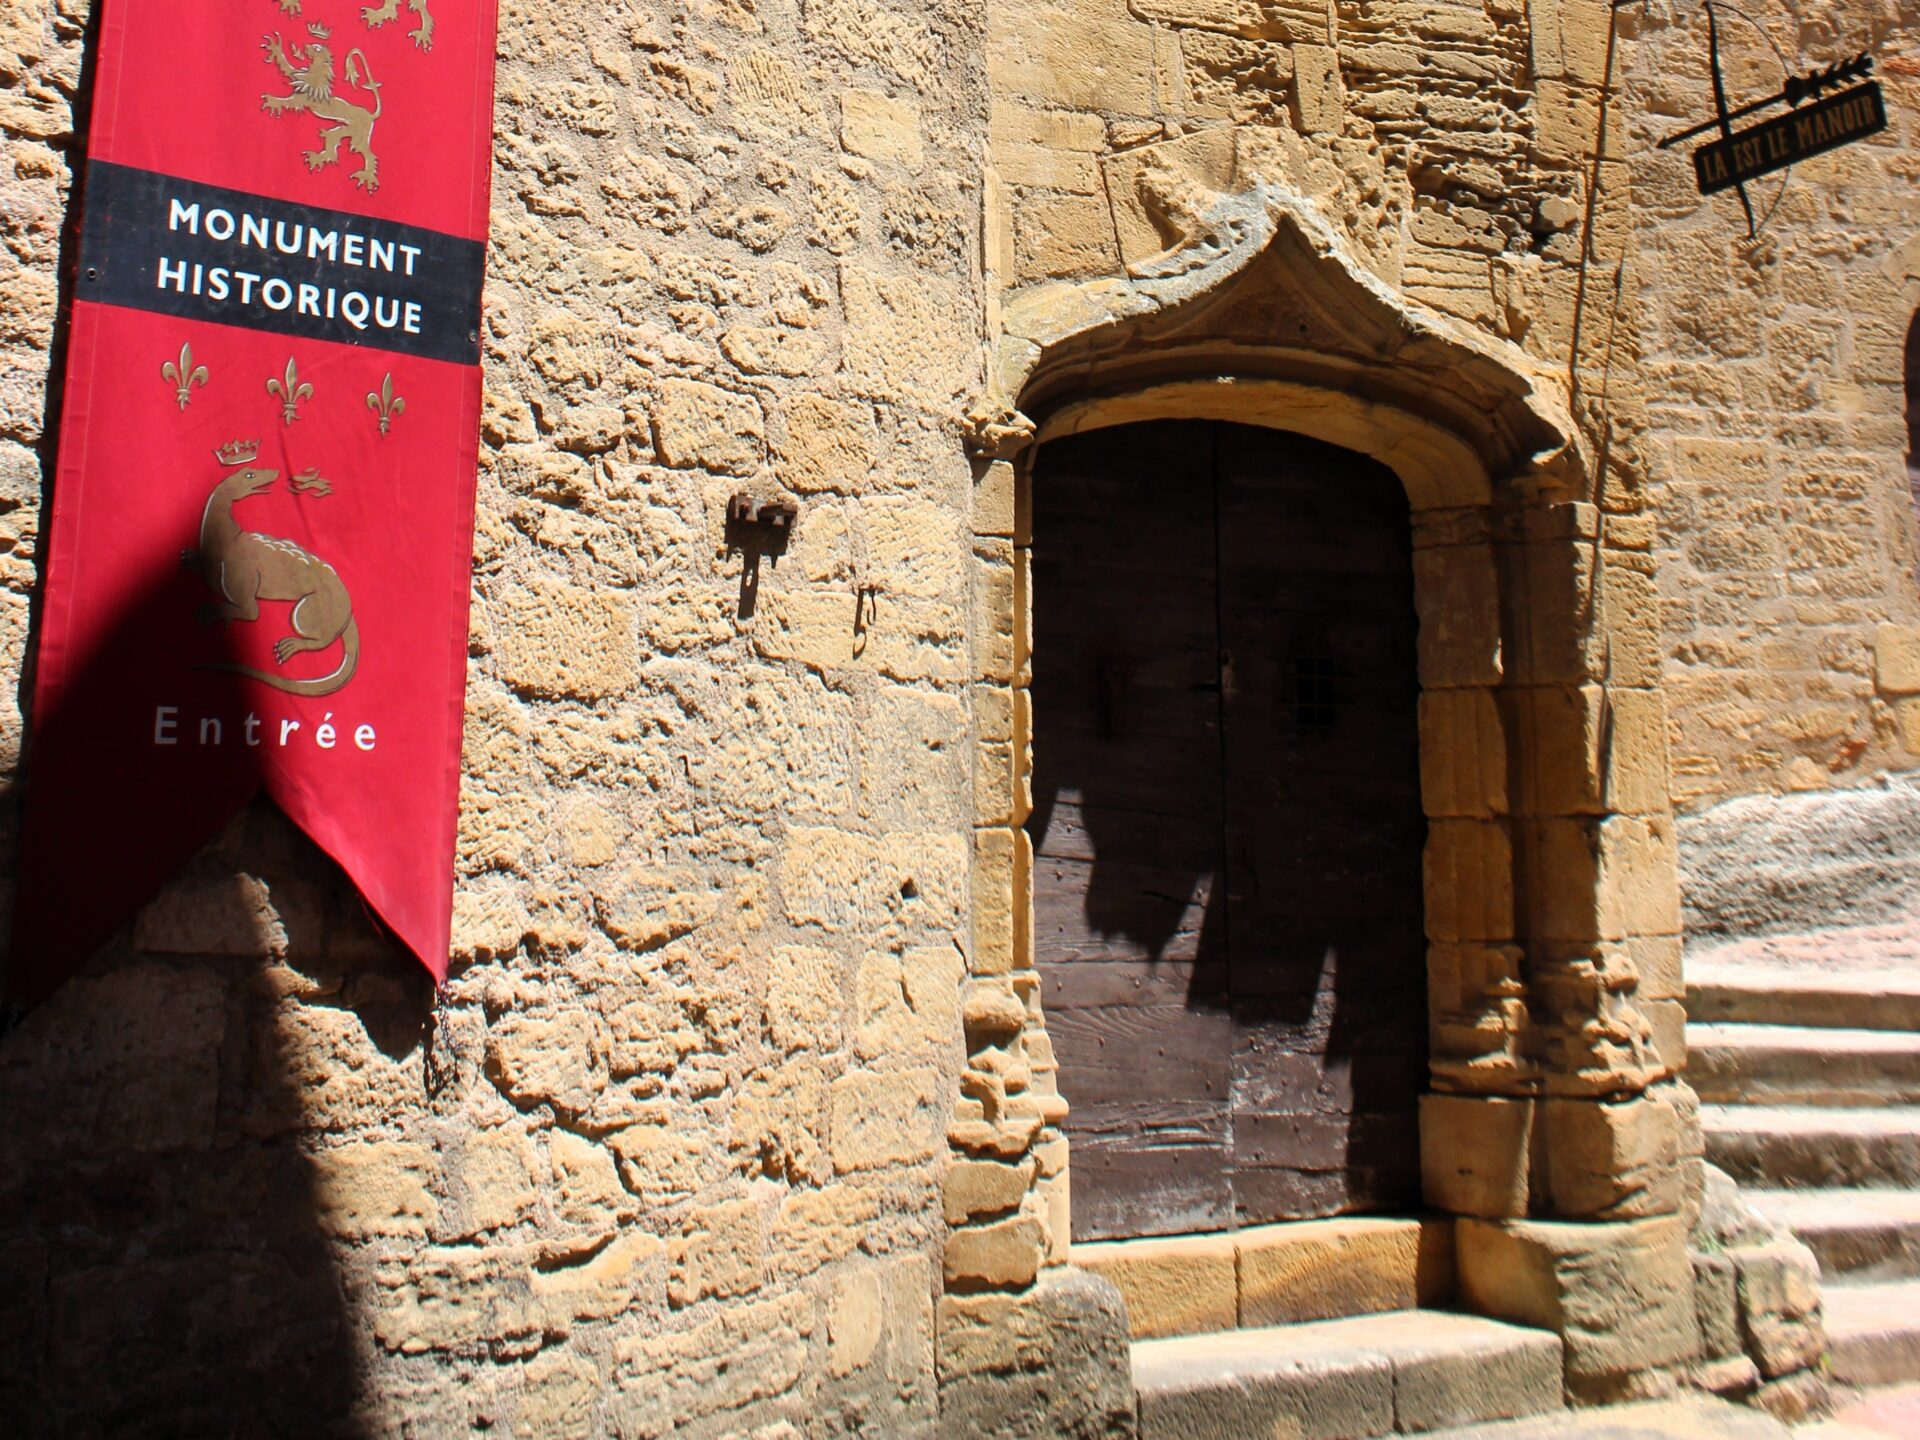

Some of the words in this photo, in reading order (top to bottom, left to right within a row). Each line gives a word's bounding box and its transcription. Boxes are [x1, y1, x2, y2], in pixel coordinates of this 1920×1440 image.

[1702, 151, 1728, 184] LA
[1732, 136, 1763, 173] EST
[1765, 126, 1790, 162] LE
[1794, 95, 1877, 151] MANOIR
[168, 198, 421, 276] MONUMENT
[157, 256, 422, 334] HISTORIQUE
[153, 705, 376, 751] Entrée
